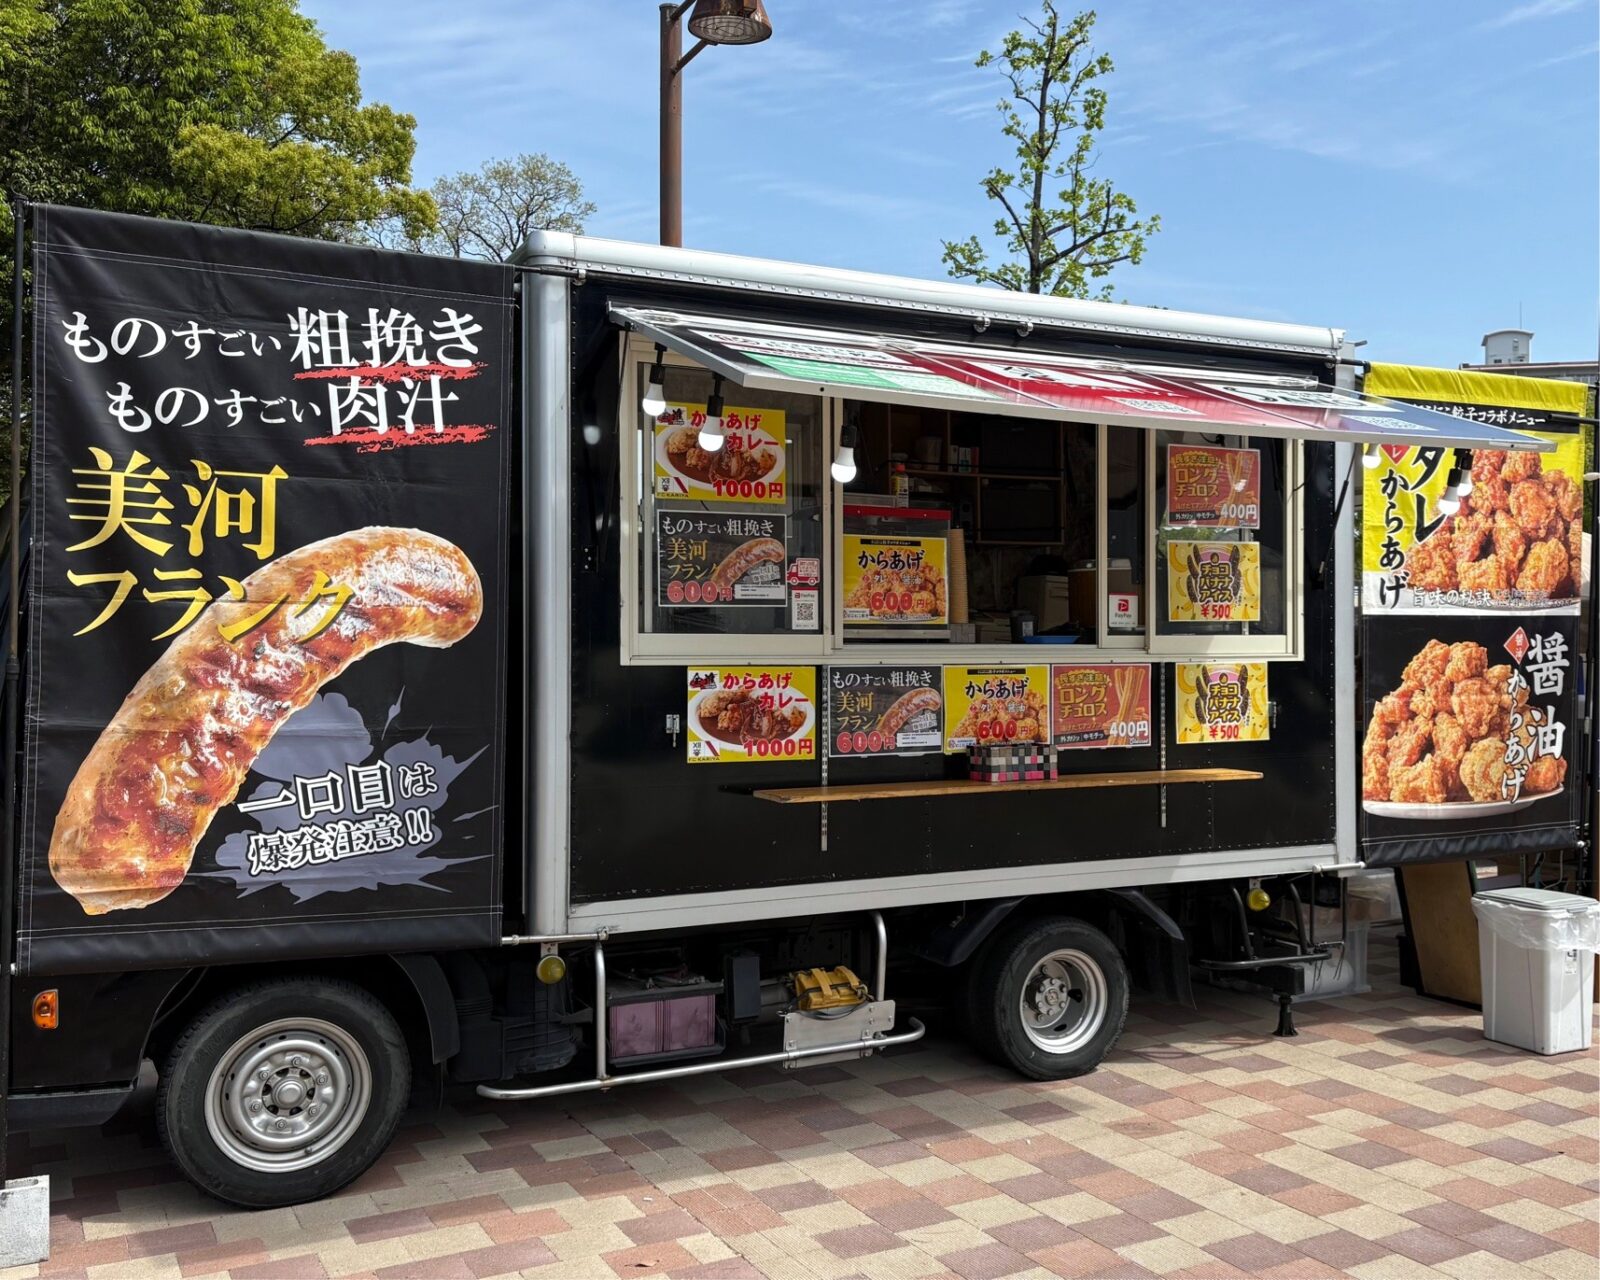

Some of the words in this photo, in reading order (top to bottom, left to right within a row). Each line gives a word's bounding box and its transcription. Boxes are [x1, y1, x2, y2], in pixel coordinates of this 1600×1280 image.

[61, 306, 484, 369] ものすごい粗挽き
[106, 375, 460, 435] ものすごい肉汁
[727, 432, 779, 450] カレー
[1175, 466, 1219, 484] ロング
[712, 479, 784, 499] 1000円
[1175, 483, 1219, 497] チュロス
[1408, 446, 1449, 545] タレ
[65, 446, 290, 560] 美河
[1220, 503, 1258, 520] 400円
[667, 537, 709, 561] 美河
[1378, 468, 1411, 610] からあげ
[858, 549, 926, 571] からあげ
[1201, 564, 1231, 576] チョコ
[1200, 575, 1232, 588] バナナ
[667, 580, 733, 604] 600円
[871, 590, 927, 612] 600円
[1199, 589, 1232, 602] アイス
[1413, 586, 1494, 609] 旨味の秘訣
[66, 567, 356, 643] フランク
[1200, 603, 1231, 618] ¥500
[722, 672, 794, 690] からあげ
[965, 676, 1030, 699] からあげ
[1209, 684, 1239, 696] チョコ
[759, 692, 810, 709] カレー
[836, 690, 874, 713] 美河
[1060, 685, 1107, 705] ロング
[1208, 697, 1240, 709] バナナ
[1525, 631, 1570, 762] 醤油
[1060, 703, 1108, 719] チュロス
[1207, 709, 1241, 723] アイス
[977, 719, 1030, 739] 600円
[1109, 720, 1149, 738] 400円
[1209, 724, 1240, 739] ¥500
[1501, 668, 1528, 804] からあげ
[743, 738, 813, 757] 1000円
[836, 730, 896, 753] 600円
[237, 760, 438, 820] 一口目は
[247, 807, 433, 876] 爆発注意!!
